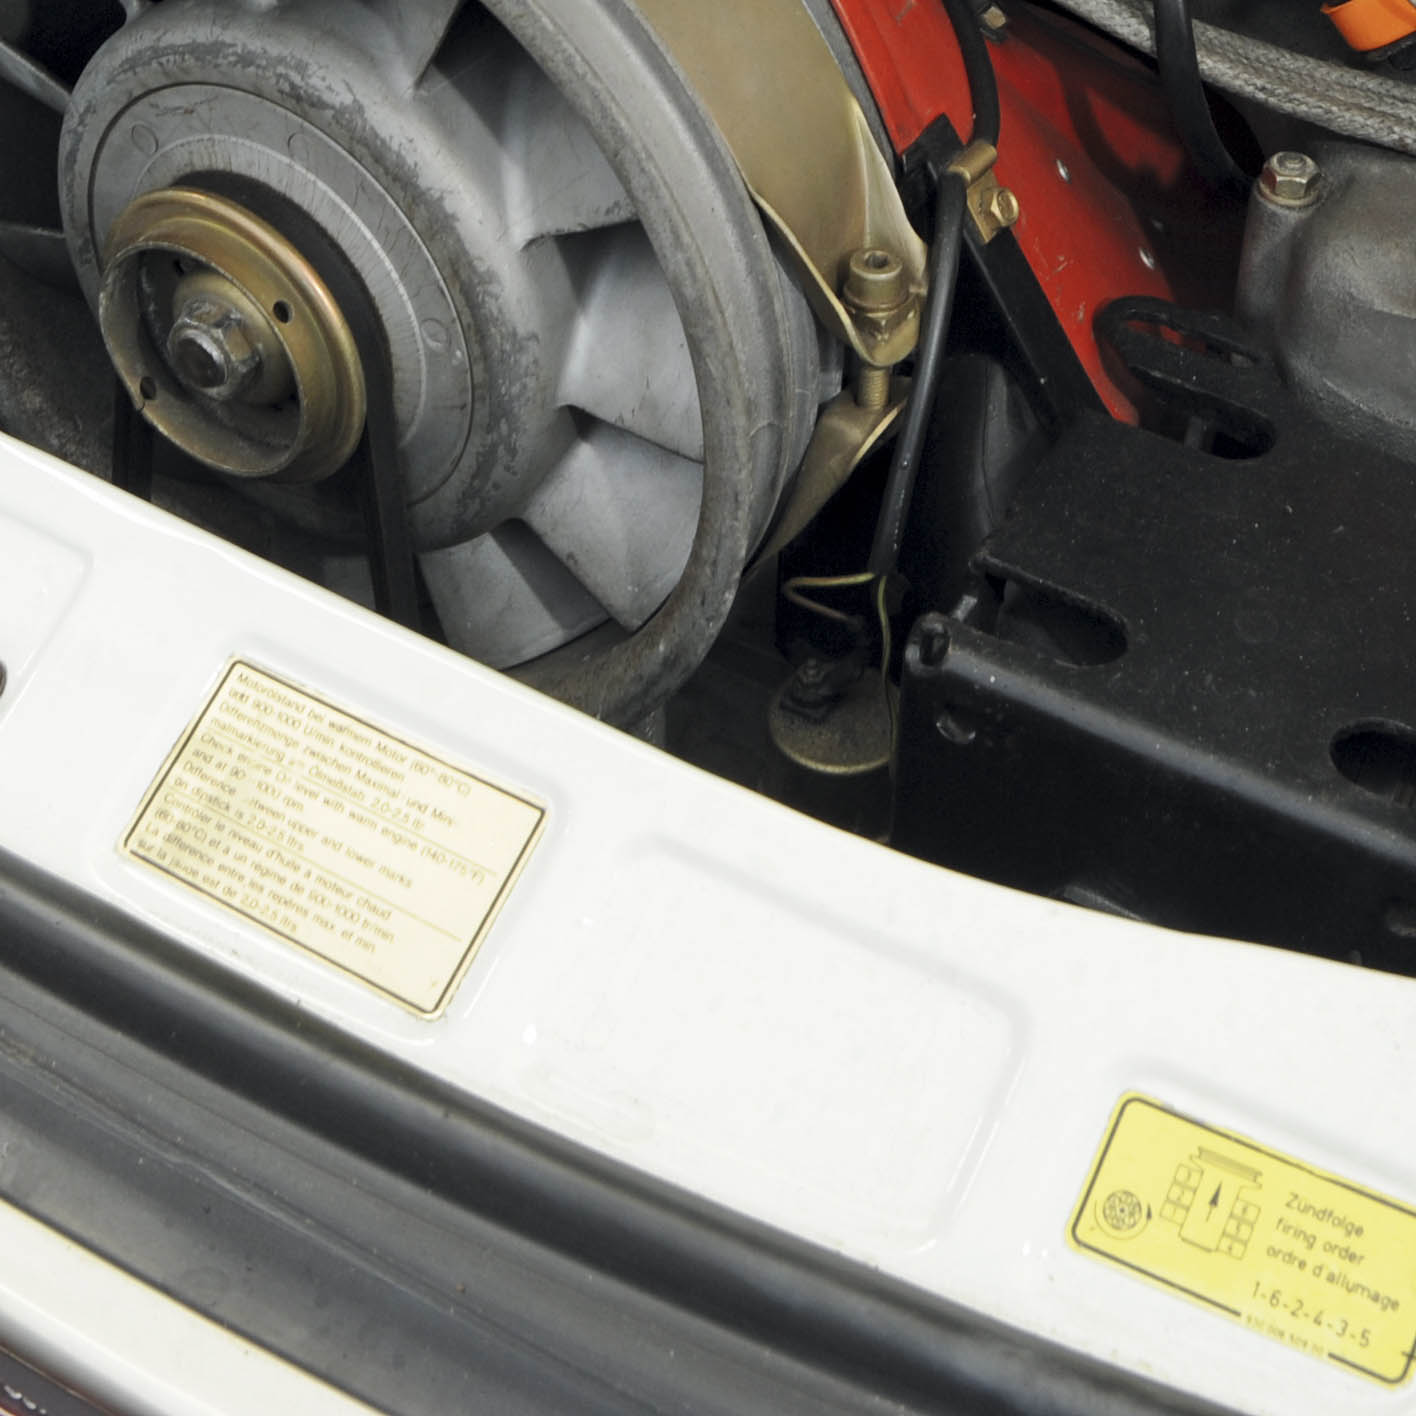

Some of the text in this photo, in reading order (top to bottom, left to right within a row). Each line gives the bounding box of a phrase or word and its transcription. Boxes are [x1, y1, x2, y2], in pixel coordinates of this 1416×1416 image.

[375, 740, 408, 763] Motor
[172, 776, 188, 791] on
[191, 786, 230, 812] dipstick
[192, 747, 213, 764] and
[214, 758, 227, 771] at
[282, 795, 304, 813] rpm
[200, 732, 233, 755] Check
[323, 794, 346, 812] with
[347, 808, 377, 830] warm
[379, 826, 417, 852] engine
[405, 796, 428, 814] und
[183, 761, 236, 794] Difference
[286, 818, 316, 839] upper
[321, 832, 343, 850] and
[345, 847, 374, 868] lower
[377, 865, 412, 888] marks
[136, 838, 154, 853] sur
[201, 873, 219, 888] est
[221, 884, 237, 898] de
[144, 821, 160, 836] La
[218, 860, 246, 881] entre
[248, 876, 266, 892] les
[228, 829, 262, 852] niveau
[315, 875, 352, 899] moteur
[355, 895, 390, 919] chaud
[233, 850, 248, 864] un
[289, 879, 306, 894] de
[1266, 1243, 1306, 1271] ordre
[1274, 1217, 1363, 1265] firing order
